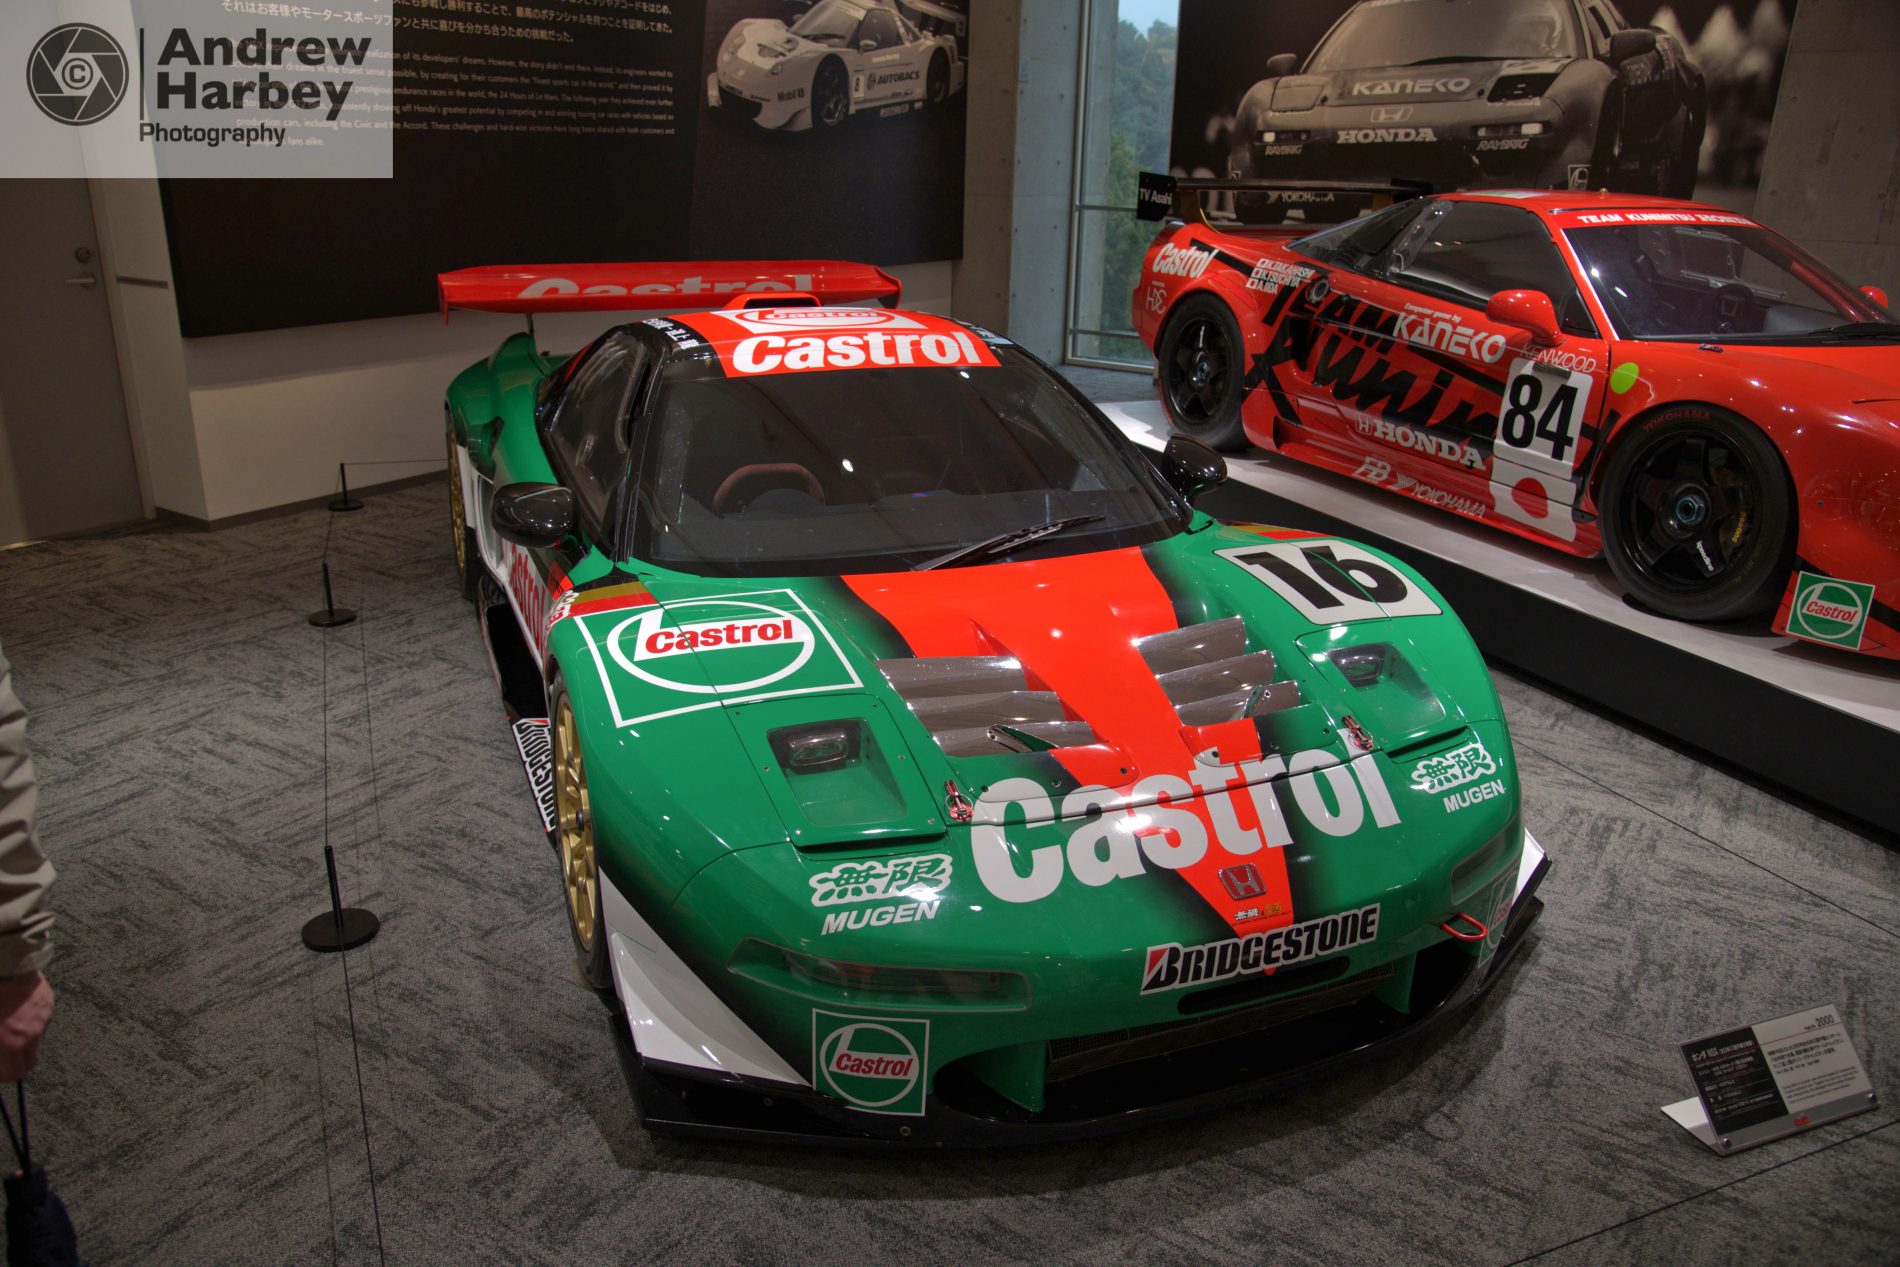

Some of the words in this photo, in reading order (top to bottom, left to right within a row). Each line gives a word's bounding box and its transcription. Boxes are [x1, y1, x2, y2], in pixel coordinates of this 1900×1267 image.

[877, 70, 920, 85] AUTOBACS
[1352, 78, 1471, 96] KANEKO
[1336, 128, 1437, 144] HONDA
[1477, 138, 1530, 150] RAYBRIG
[1139, 188, 1151, 201] TV
[1151, 190, 1173, 206] Asahi
[1577, 213, 1625, 224] TEAM
[1152, 242, 1220, 278] Castrol
[732, 331, 982, 373] Castrol
[1392, 312, 1506, 364] KANEKO
[1520, 343, 1597, 374] KENWOOD
[1502, 374, 1579, 461] 84
[1372, 420, 1487, 471] HONDA
[1410, 483, 1487, 518] YOKOHAMA
[1233, 545, 1408, 610] 16
[1805, 601, 1858, 623] Castrol
[645, 619, 793, 654] Castrol
[1443, 779, 1505, 813] MUGEN
[970, 729, 1402, 903] Castrol
[809, 853, 953, 907] 無限
[820, 900, 941, 936] MUGEN
[1141, 906, 1378, 992] BRIDGESTONE
[835, 1053, 913, 1077] Castrol
